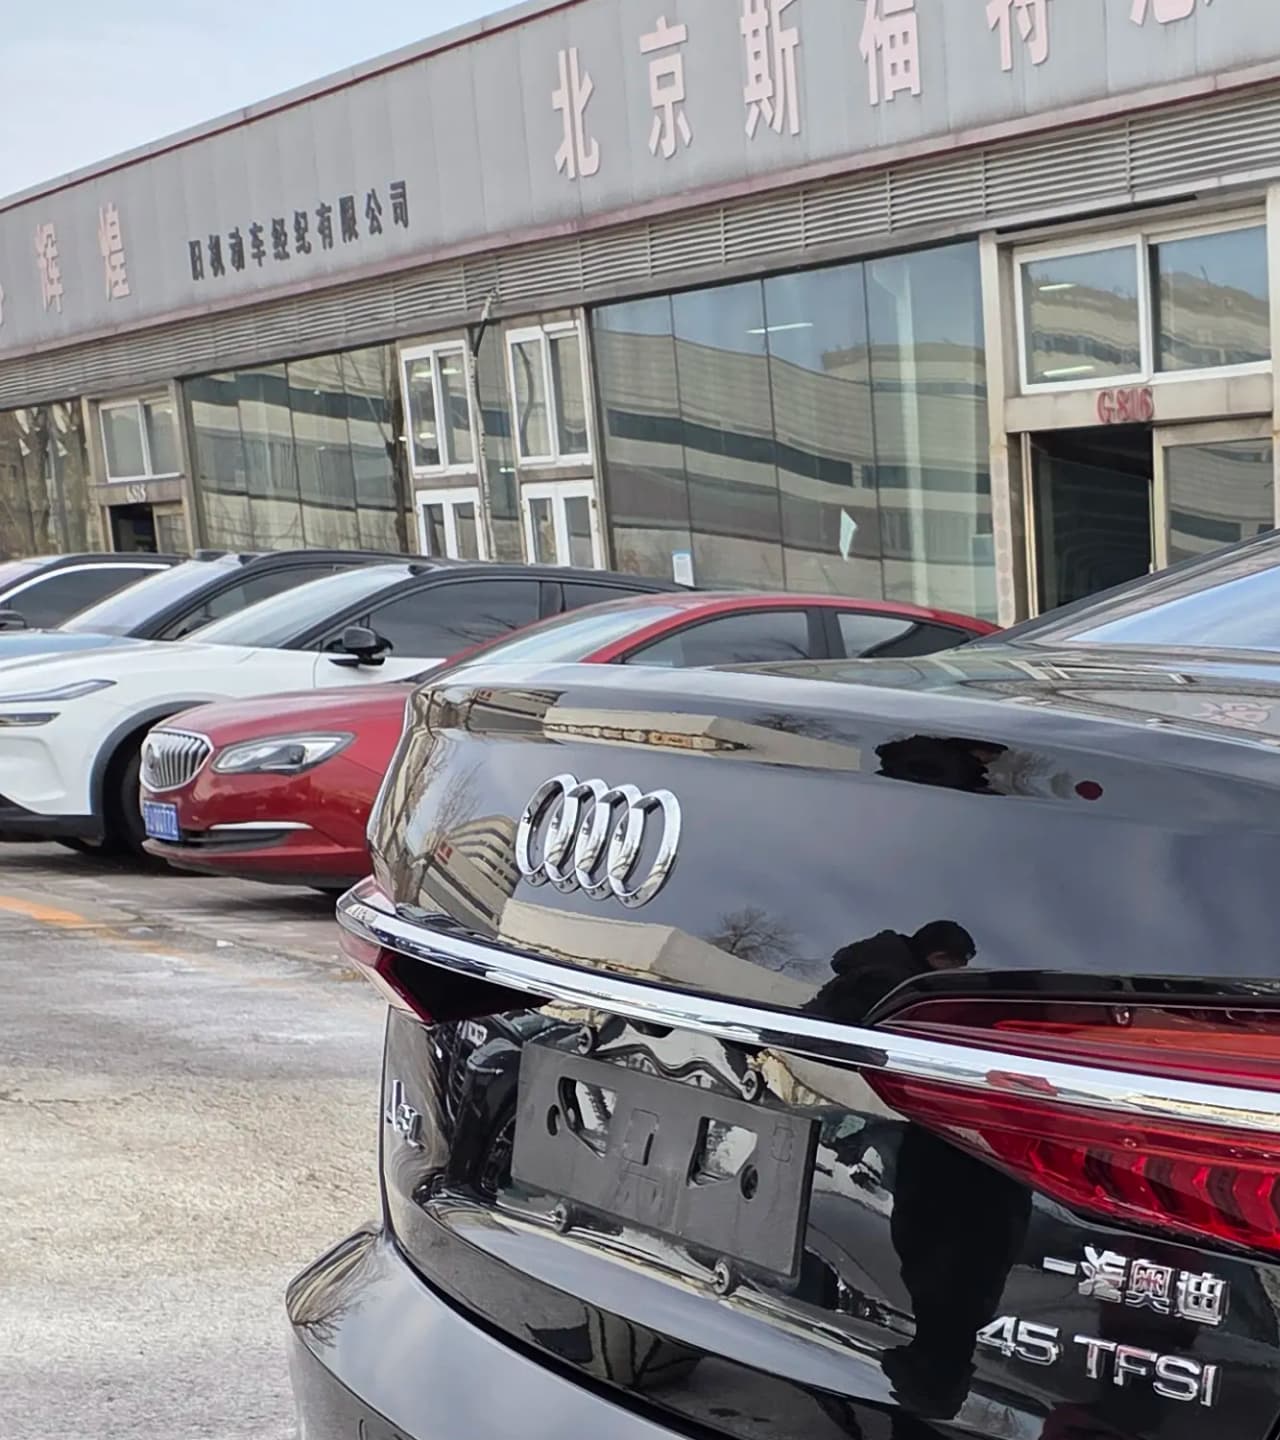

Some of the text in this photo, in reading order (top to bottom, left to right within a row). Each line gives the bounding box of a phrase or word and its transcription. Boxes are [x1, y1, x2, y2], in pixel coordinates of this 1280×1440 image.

[551, 0, 1213, 181] 北京斯福
[0, 202, 131, 326] 辉煌
[1042, 1244, 1227, 1326] 一汽奥迪
[976, 1316, 1217, 1407] 45 TFSI
